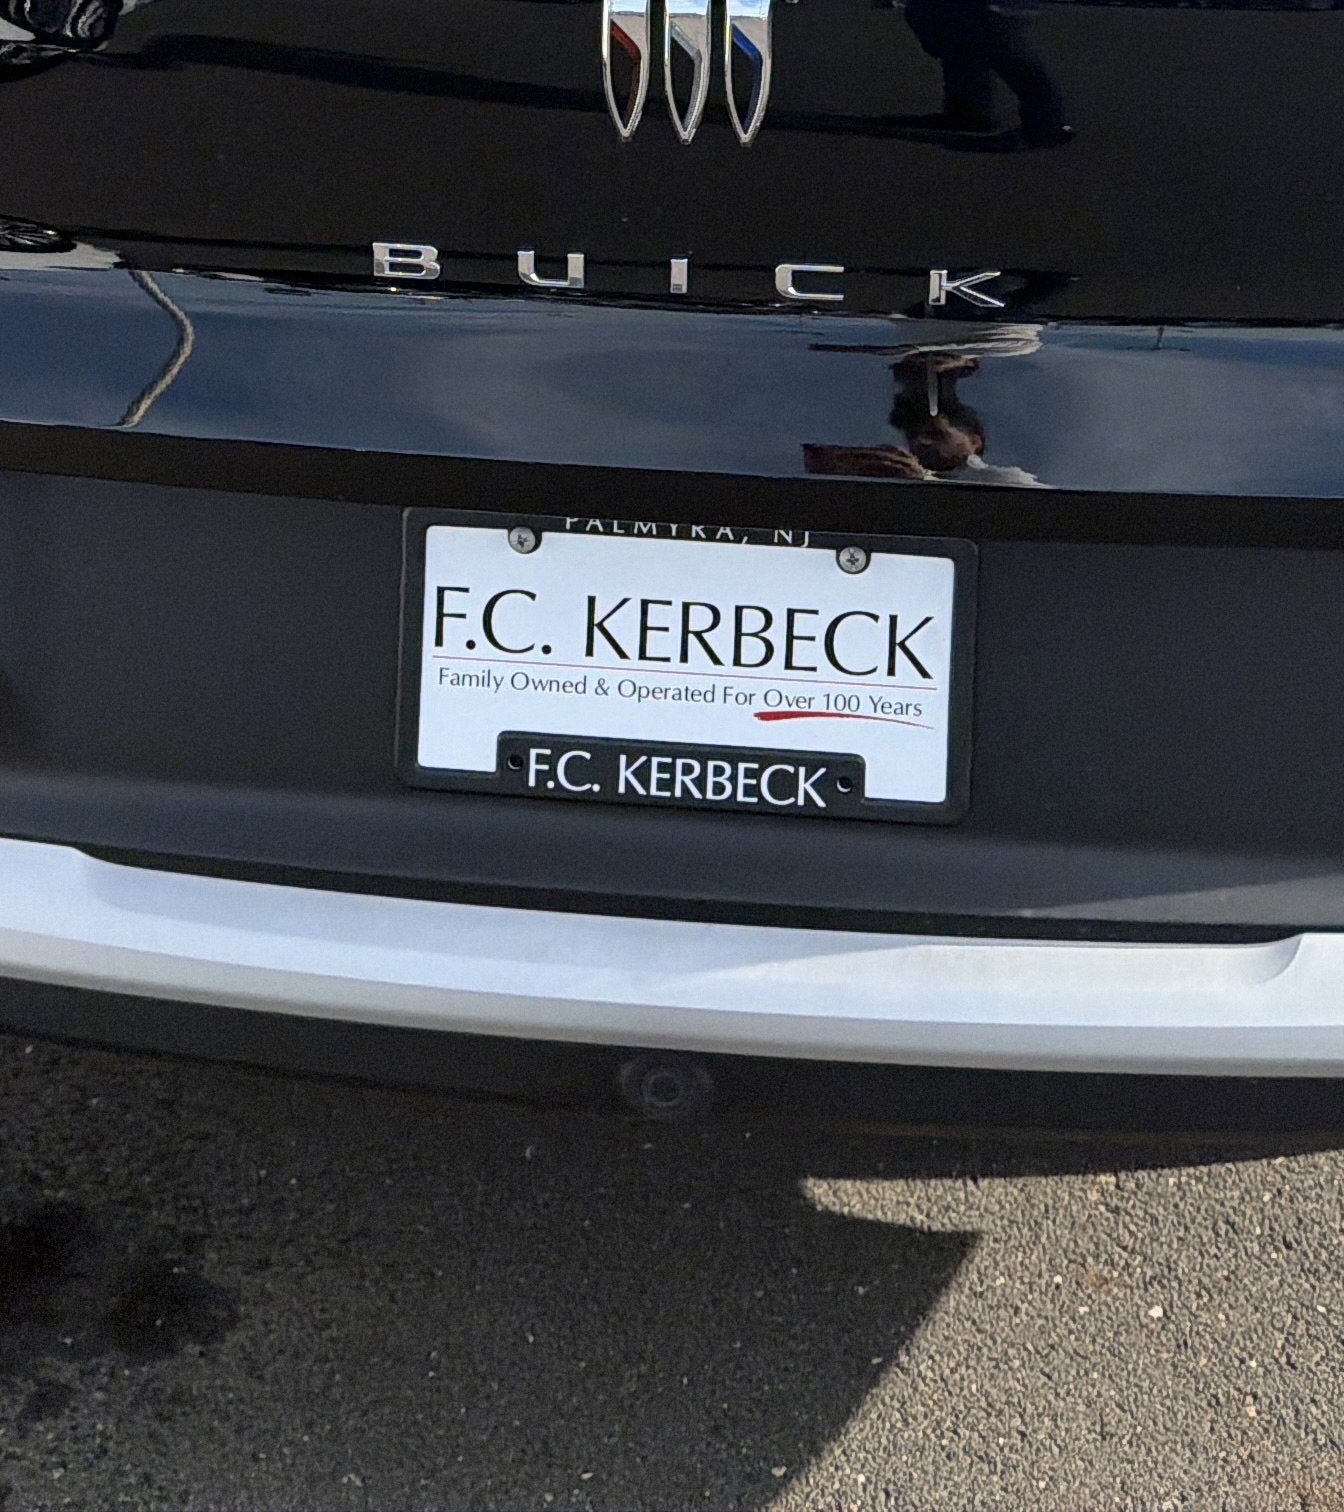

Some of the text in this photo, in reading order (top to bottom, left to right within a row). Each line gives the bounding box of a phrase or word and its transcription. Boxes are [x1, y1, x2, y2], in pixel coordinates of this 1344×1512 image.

[372, 241, 1006, 308] BUICK
[565, 517, 810, 548] PALMYRA, NJ
[434, 585, 935, 679] F.C. KERBECK
[439, 667, 923, 717] Family Owned & Operated For Over 100 Years
[528, 748, 827, 808] F.C. KERBECK
